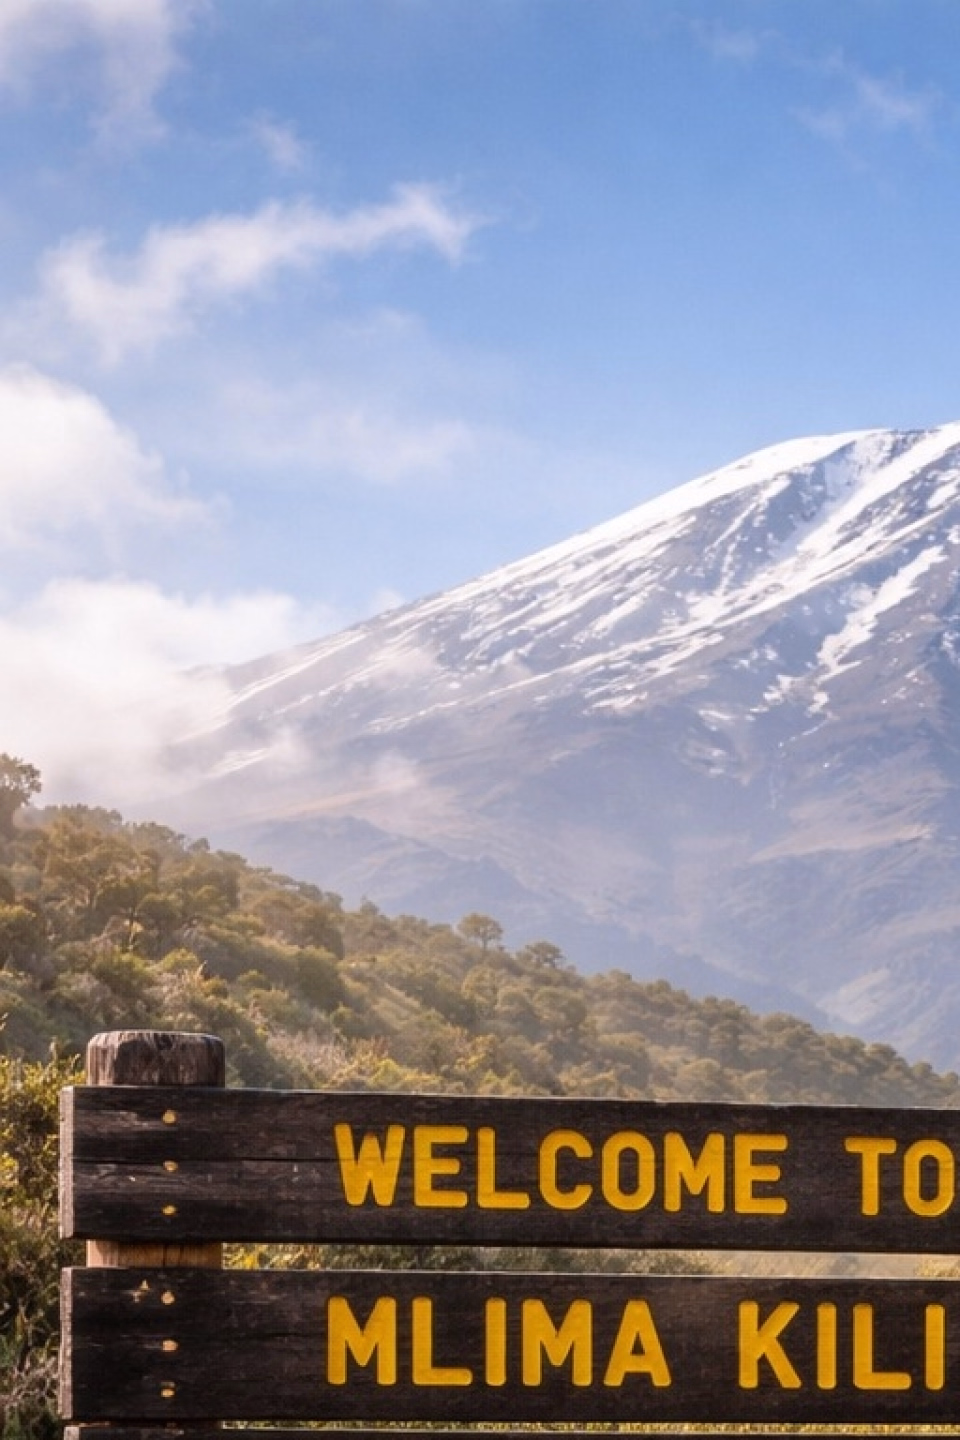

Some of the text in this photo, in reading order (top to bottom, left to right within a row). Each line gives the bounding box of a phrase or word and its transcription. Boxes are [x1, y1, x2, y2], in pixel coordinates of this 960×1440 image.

[334, 1123, 957, 1219] WELCOME TO
[326, 1296, 948, 1391] MLIMA KILI
